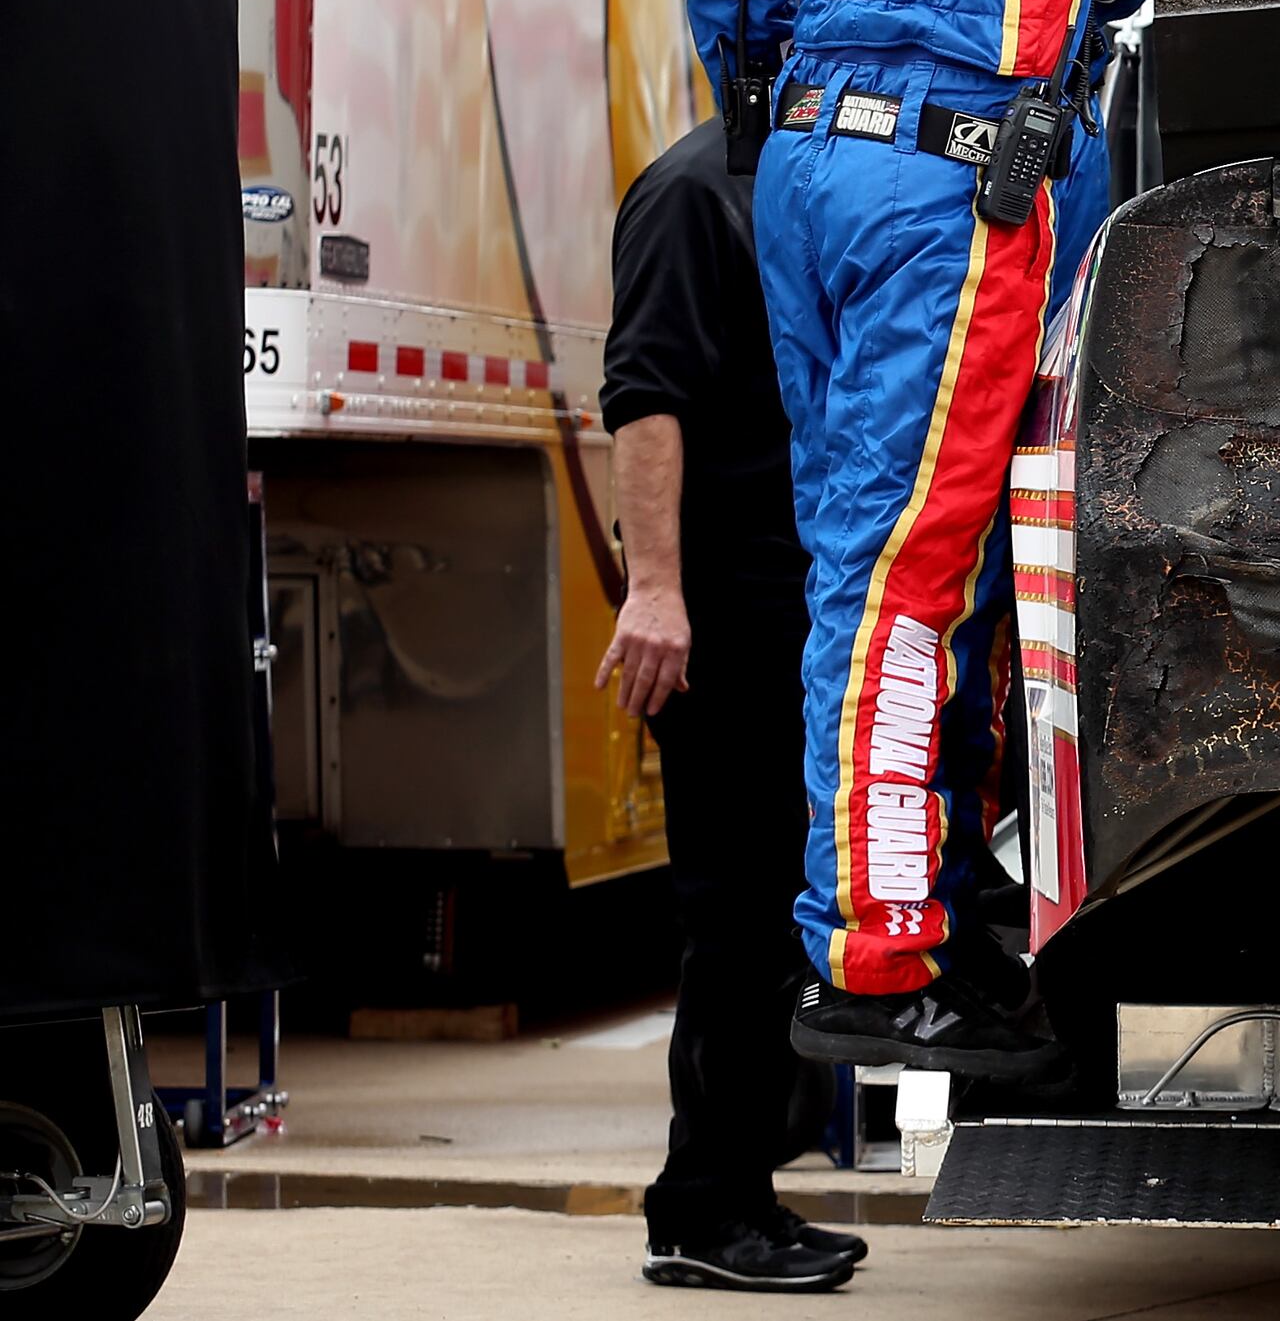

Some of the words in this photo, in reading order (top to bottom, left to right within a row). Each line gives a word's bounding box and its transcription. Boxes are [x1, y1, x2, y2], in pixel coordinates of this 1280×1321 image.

[842, 95, 887, 113] NATIONAL
[837, 107, 897, 136] GUARD
[949, 140, 991, 164] MECHA
[868, 614, 939, 785] NATIONAL
[867, 783, 930, 901] GUARD
[137, 1102, 153, 1128] 48
